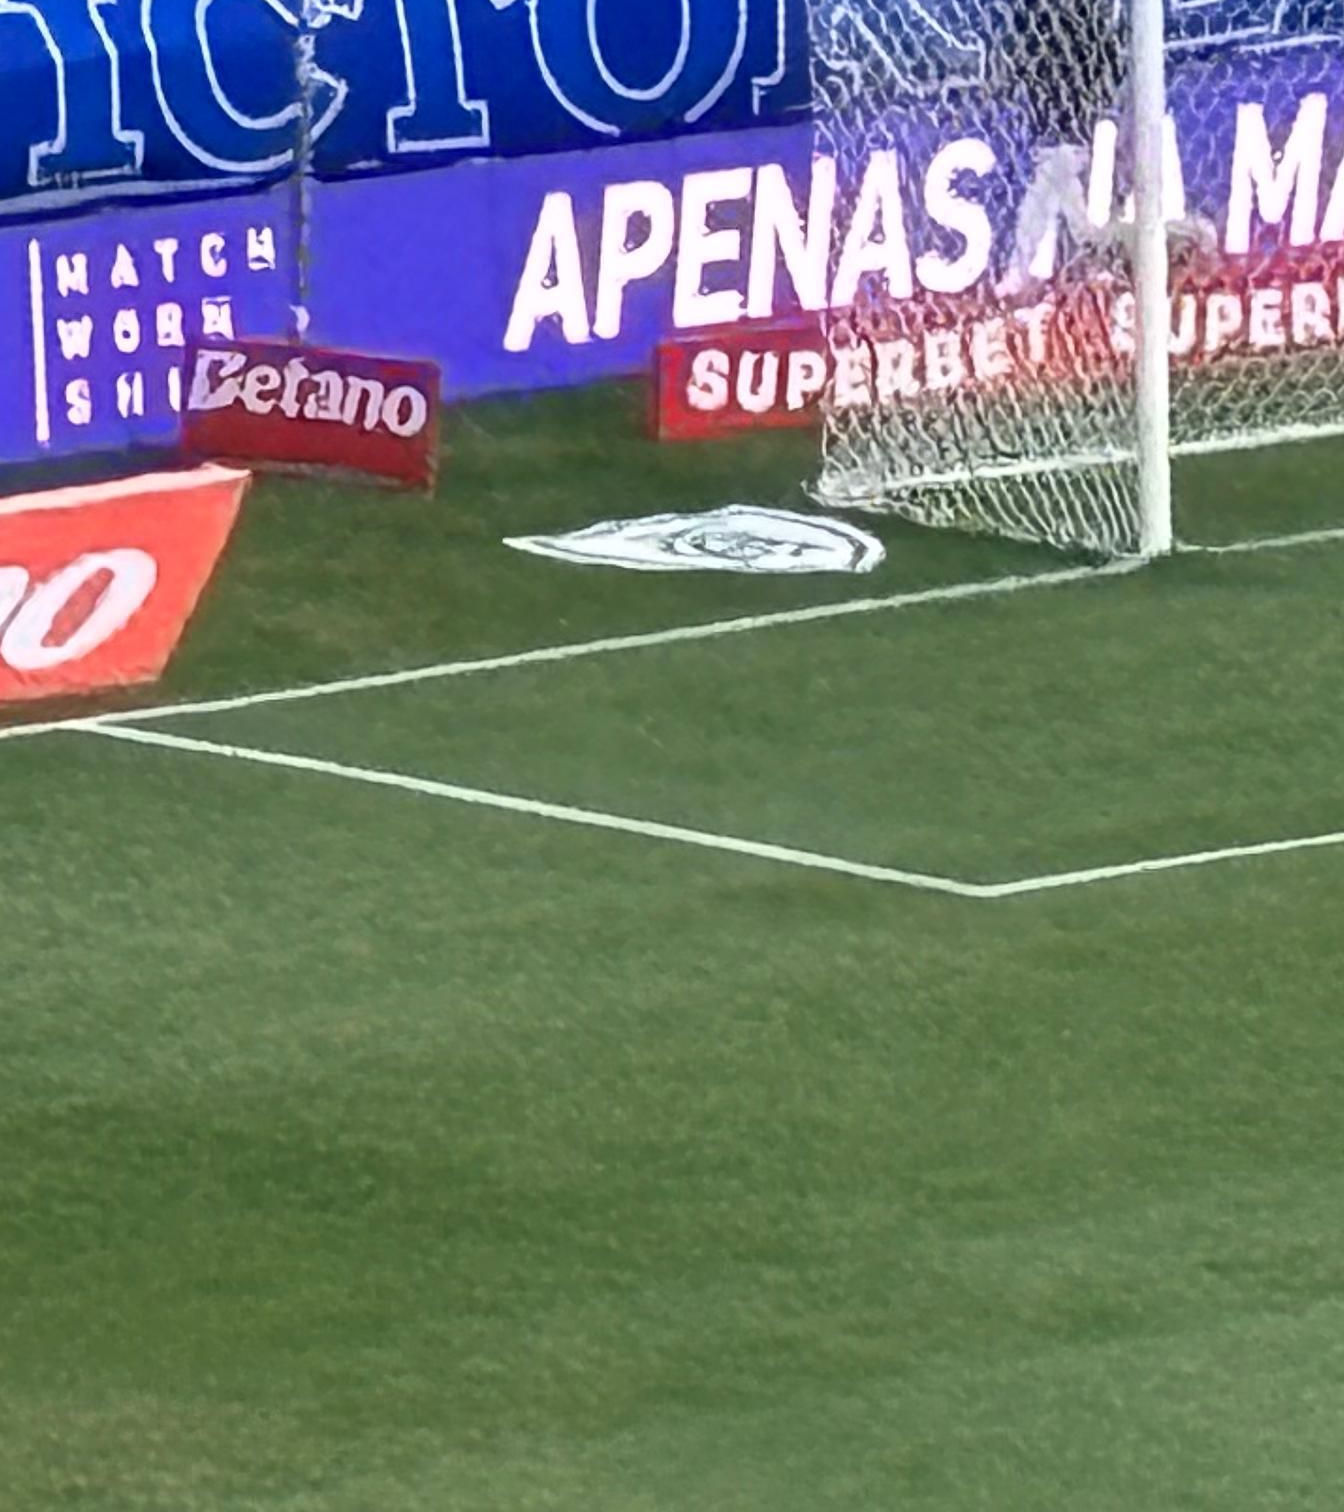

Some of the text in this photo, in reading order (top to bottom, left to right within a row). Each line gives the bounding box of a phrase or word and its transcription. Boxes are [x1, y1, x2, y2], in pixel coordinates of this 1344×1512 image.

[56, 226, 278, 298] MATCH
[504, 137, 997, 353] APENAS
[57, 296, 235, 360] WORN
[686, 301, 1058, 414] SUPERBET
[64, 365, 182, 425] SHI
[187, 348, 430, 438] Betano
